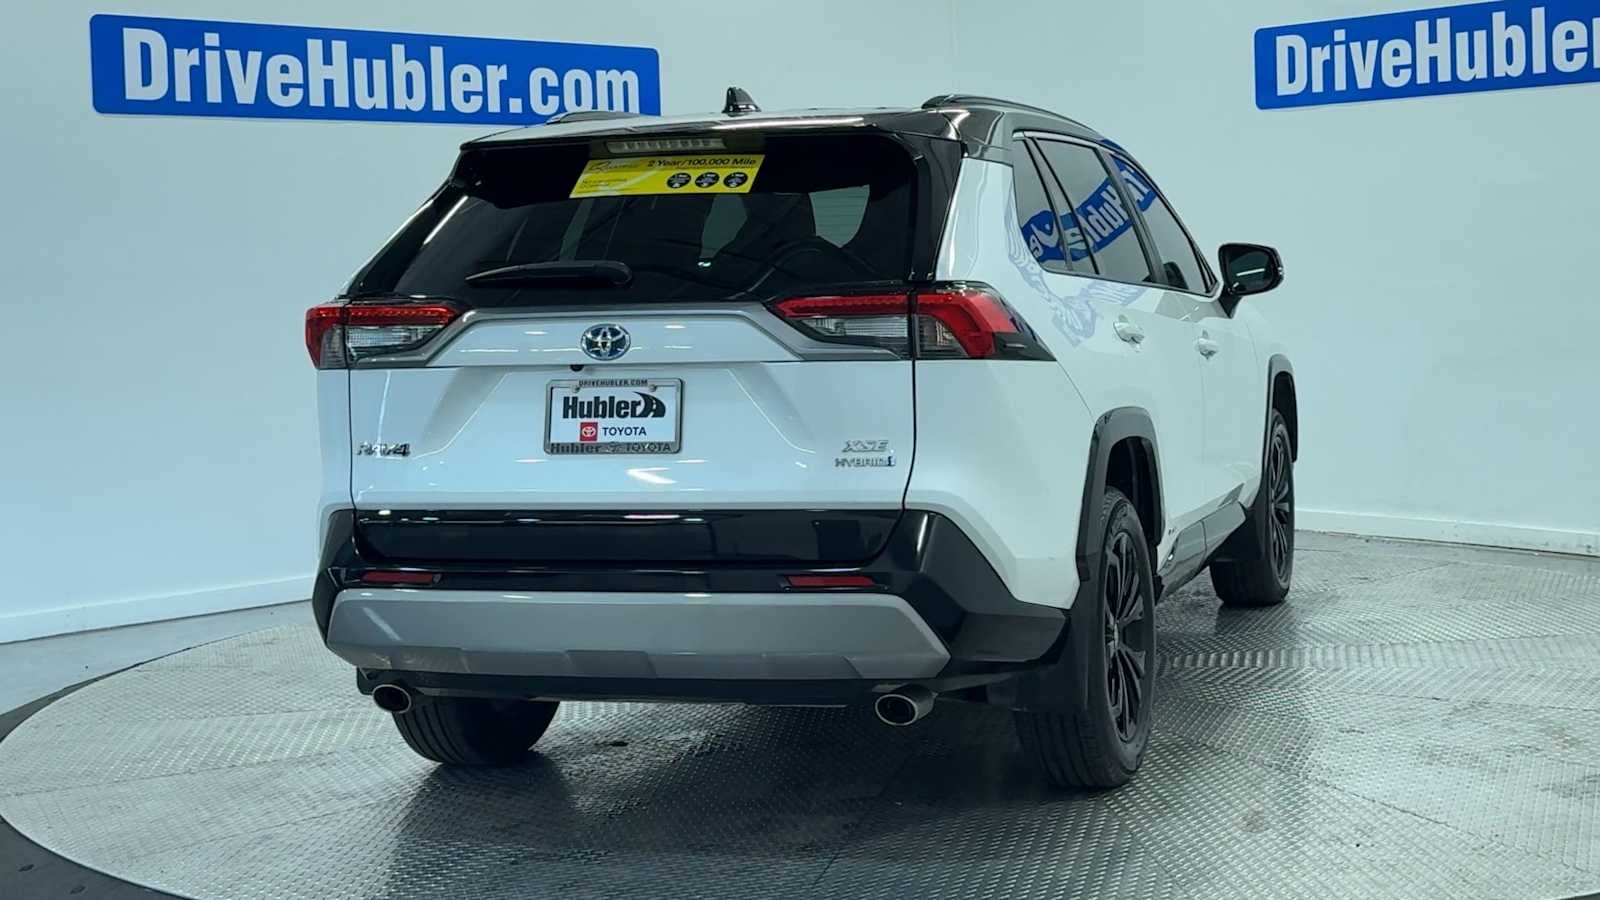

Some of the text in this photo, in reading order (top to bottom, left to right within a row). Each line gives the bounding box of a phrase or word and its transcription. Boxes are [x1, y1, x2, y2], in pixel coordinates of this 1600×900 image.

[121, 26, 640, 115] DriveHubler.com
[563, 396, 643, 418] Hubler
[602, 427, 647, 436] TOYOTA
[626, 443, 671, 452] TOYOTA
